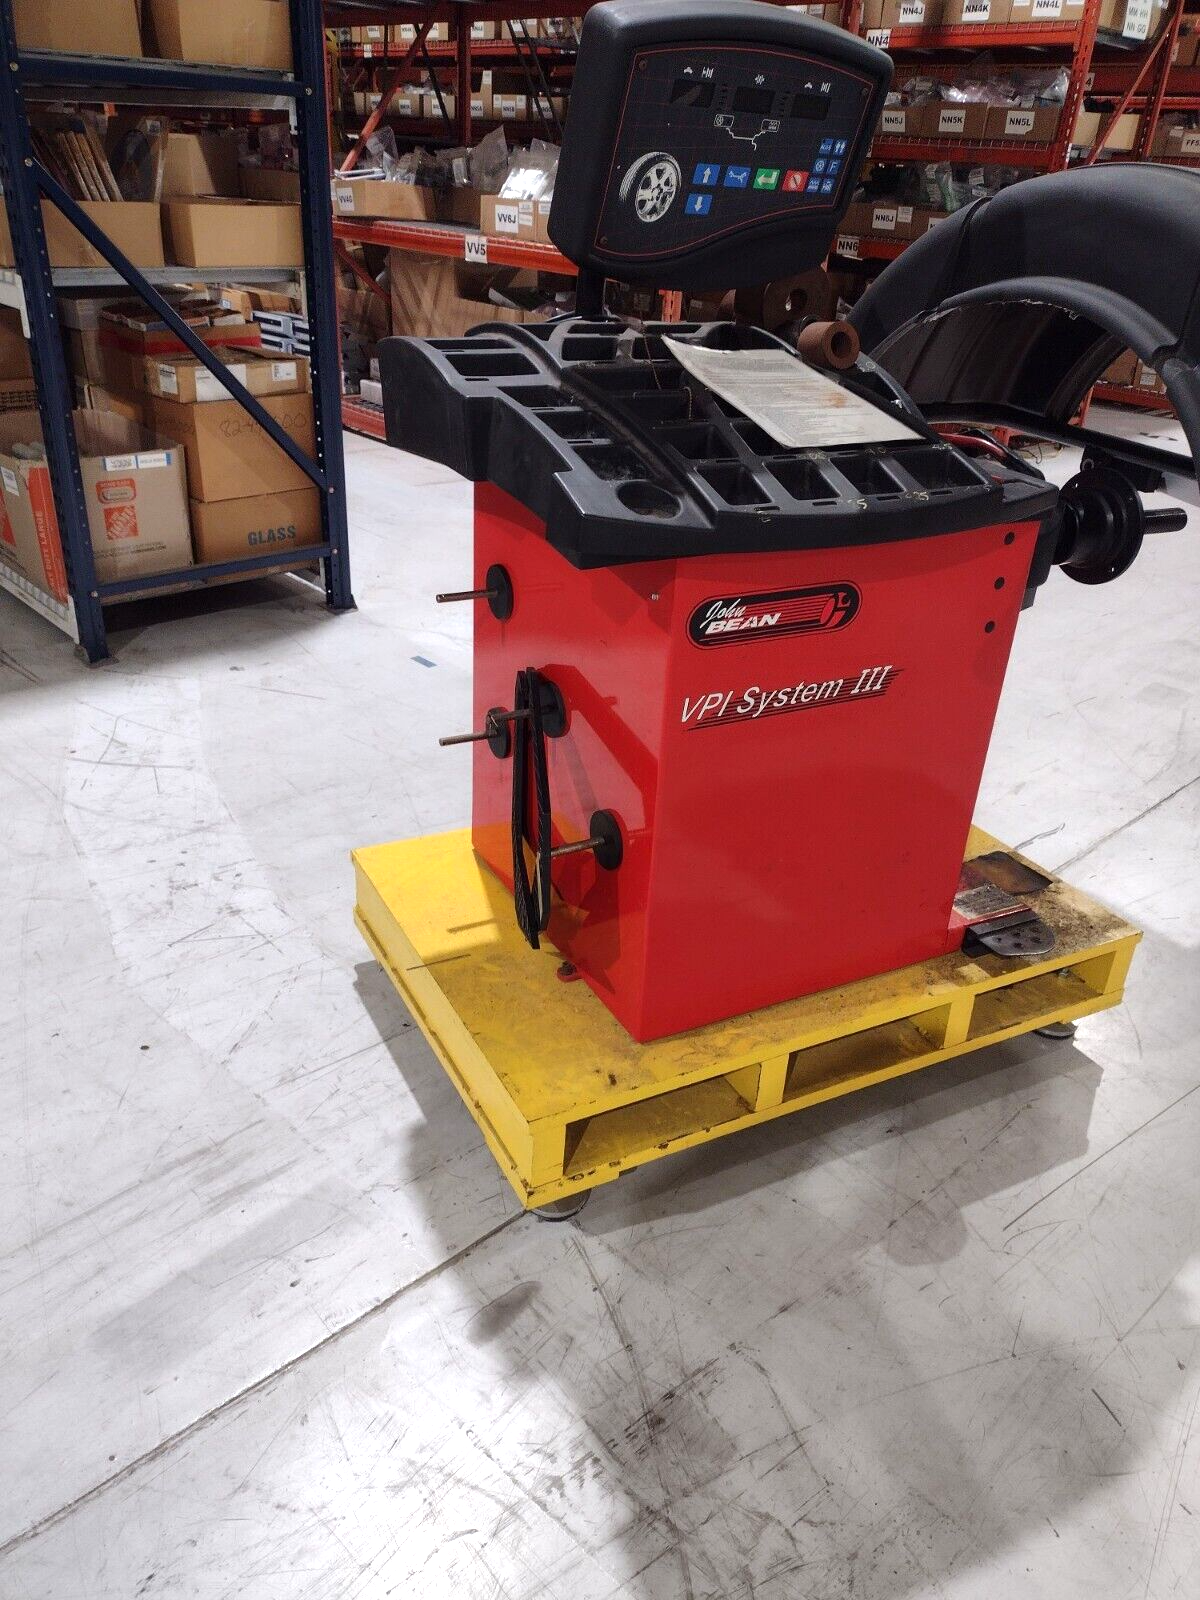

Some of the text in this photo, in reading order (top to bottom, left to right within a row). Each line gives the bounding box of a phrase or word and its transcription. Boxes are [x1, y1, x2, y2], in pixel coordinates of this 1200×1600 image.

[965, 4, 988, 13] NN4K
[1036, 0, 1060, 9] NN4L
[902, 7, 923, 15] NN4J
[867, 36, 889, 46] NN4
[941, 115, 963, 124] NN5K
[1009, 117, 1031, 126] NN5L
[497, 213, 516, 224] VV6J
[467, 242, 486, 256] VV5
[838, 240, 858, 252] NN6
[247, 525, 296, 545] GLASS
[700, 599, 746, 629] John
[705, 612, 781, 634] BEAN
[681, 665, 893, 722] VPI System III
